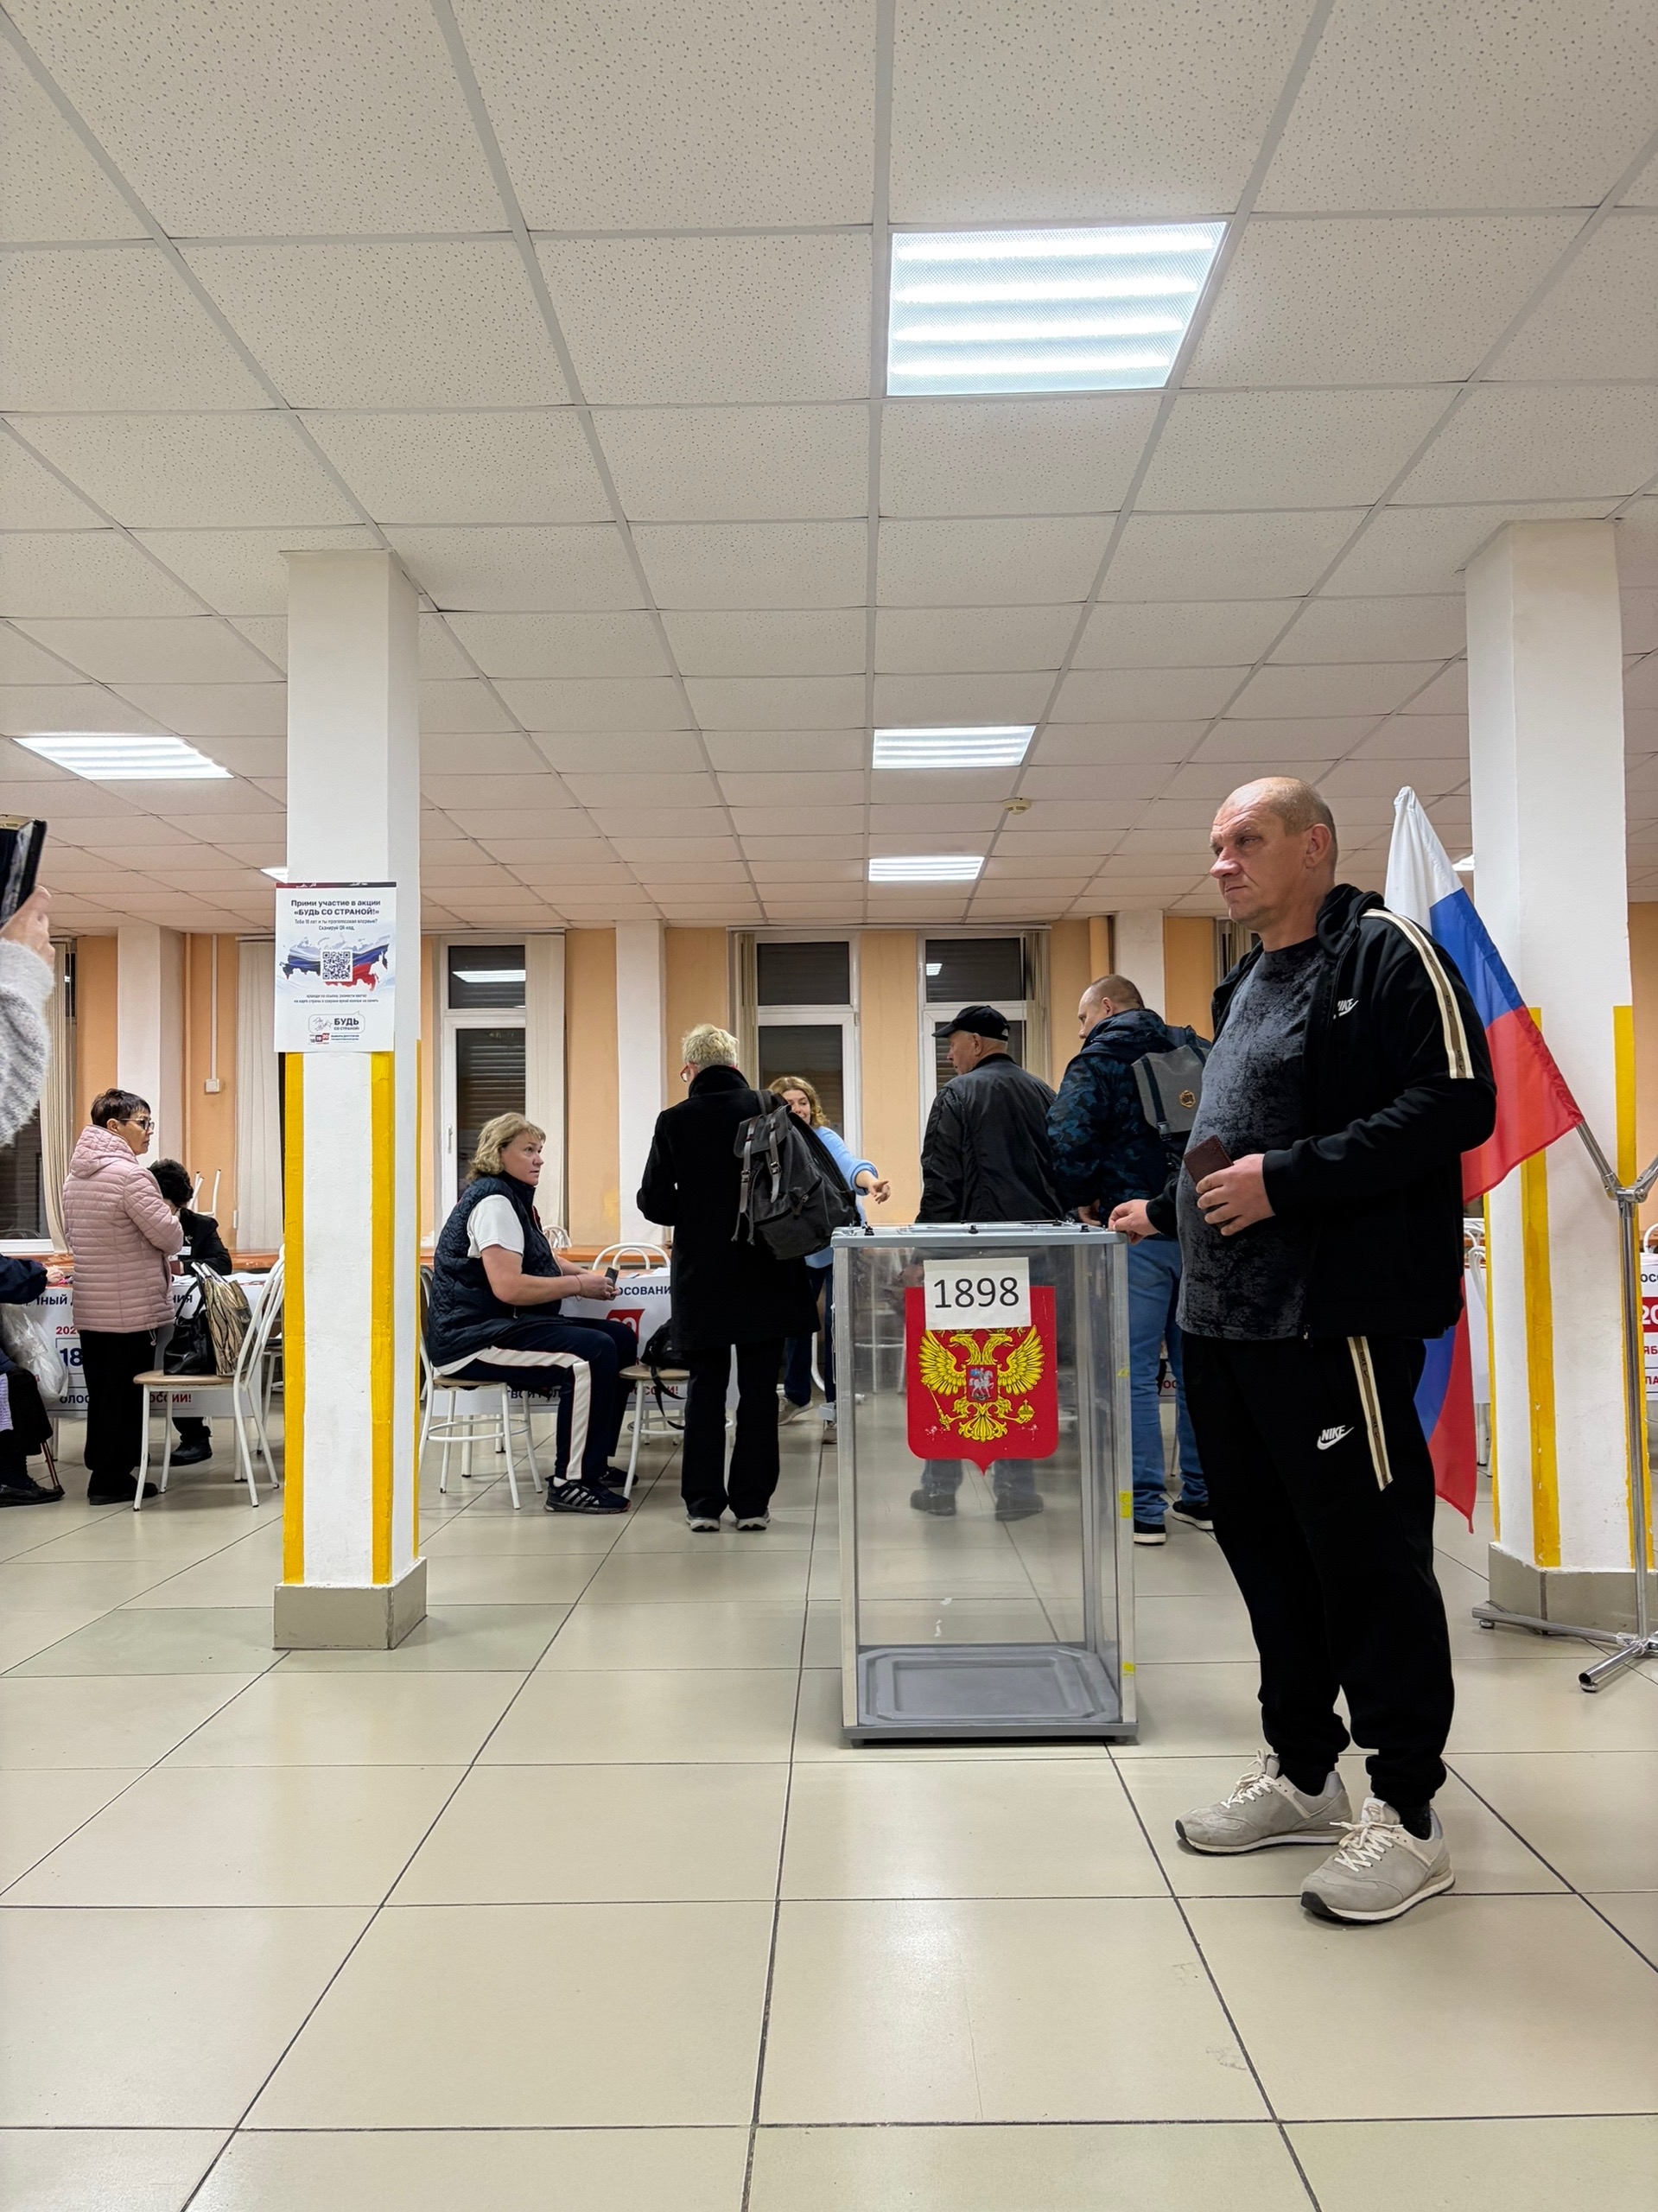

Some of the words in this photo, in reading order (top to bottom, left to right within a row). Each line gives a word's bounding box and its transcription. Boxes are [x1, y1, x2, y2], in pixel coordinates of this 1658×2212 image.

[934, 1277, 1019, 1308] 1898
[56, 1326, 79, 1335] 202
[60, 1395, 90, 1404] ОЛОС
[1321, 1425, 1346, 1441] NIKE
